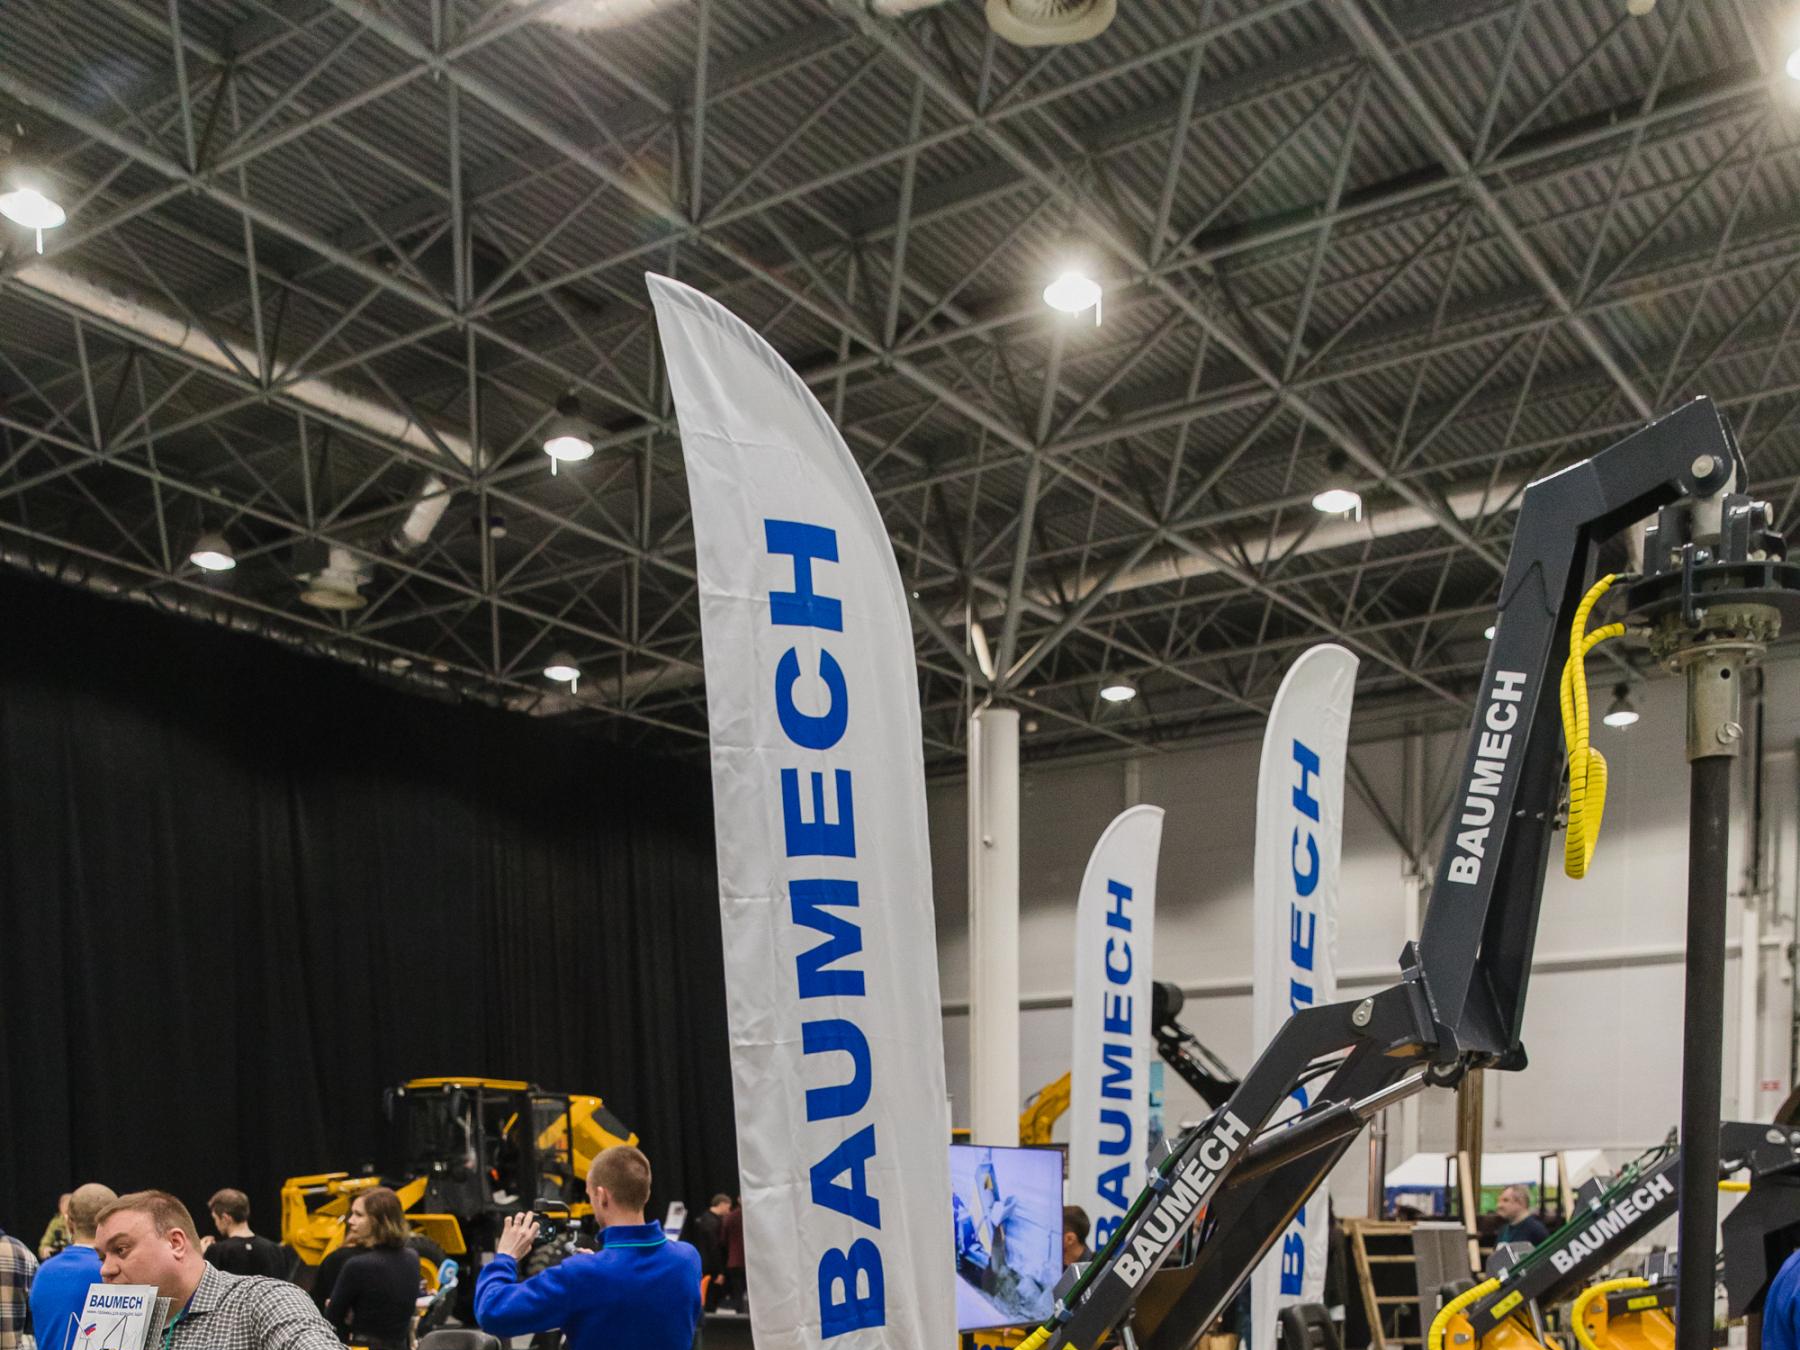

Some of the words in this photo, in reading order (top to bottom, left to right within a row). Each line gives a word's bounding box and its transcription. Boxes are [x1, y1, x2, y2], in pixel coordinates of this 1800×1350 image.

[1448, 670, 1527, 885] BAUMECH
[764, 518, 885, 1339] BAUMECH
[1113, 1111, 1250, 1288] BAUMECH
[1550, 1173, 1674, 1274] BAUMECH
[89, 1294, 144, 1309] BAUMECH
